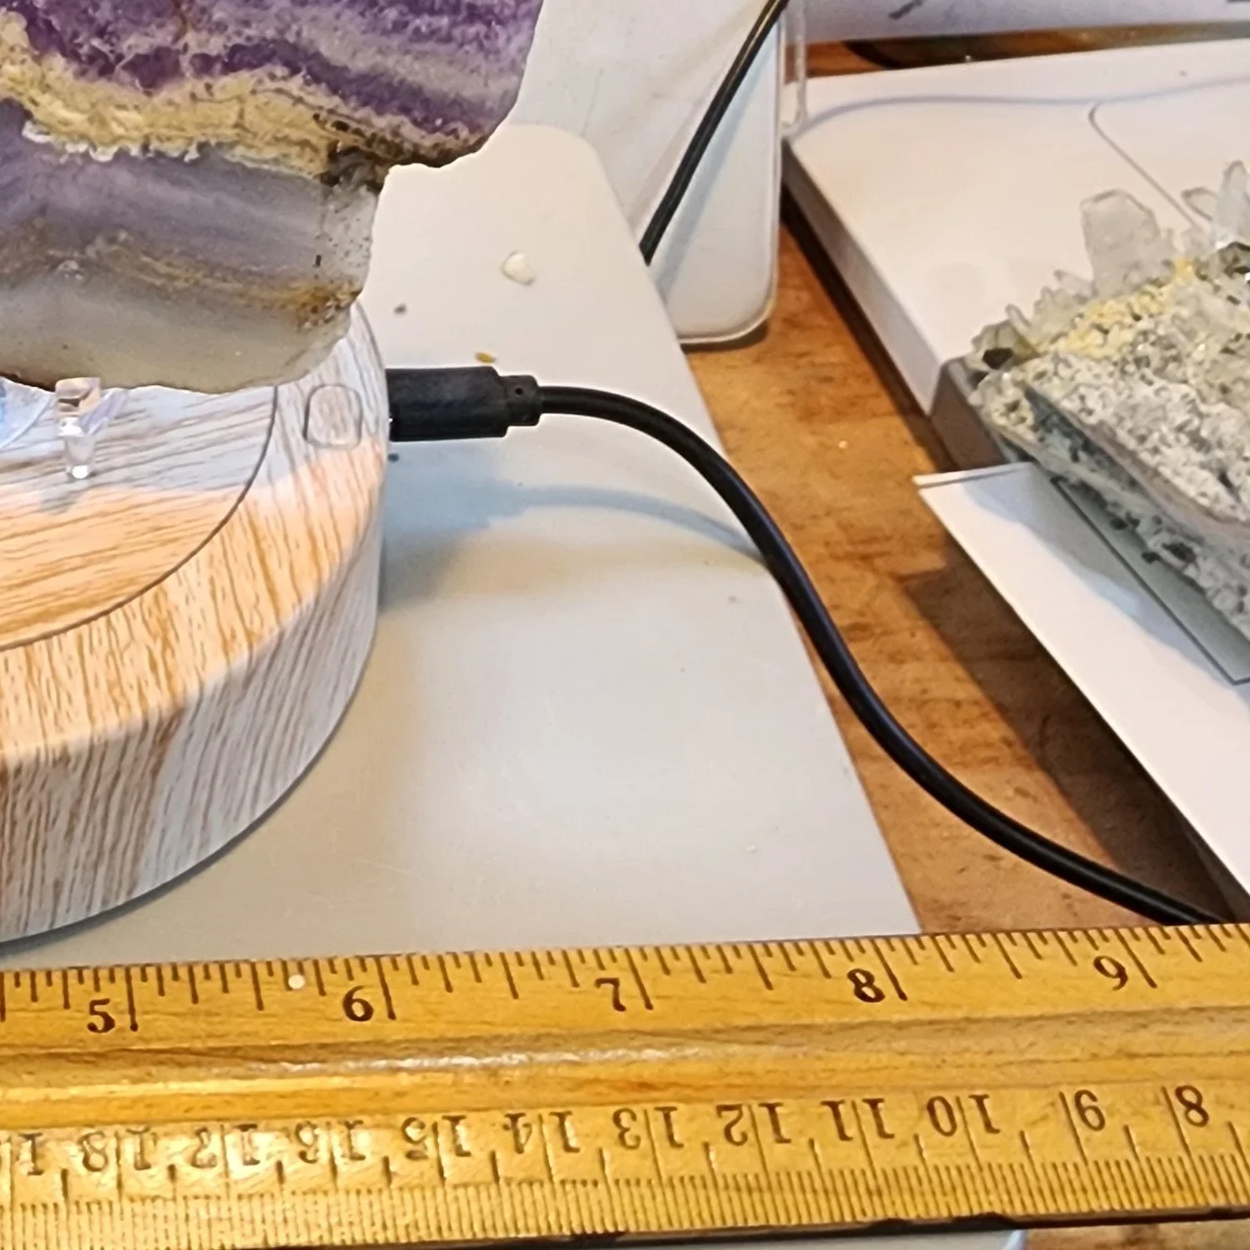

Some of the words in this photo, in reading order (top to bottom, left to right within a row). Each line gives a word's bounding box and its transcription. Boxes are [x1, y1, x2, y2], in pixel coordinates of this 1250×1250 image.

[87, 998, 117, 1033] 5
[343, 986, 373, 1022] 6
[595, 977, 626, 1011] 7
[848, 967, 883, 1004] 8
[1094, 955, 1128, 991] 9
[613, 1106, 684, 1150] 13
[717, 1102, 793, 1146] 12
[821, 1098, 897, 1141] 11
[927, 1093, 1002, 1137] 10
[1074, 1088, 1107, 1132] 9
[1176, 1084, 1210, 1129] 8
[82, 1128, 153, 1173] 18
[294, 1120, 366, 1162] 16
[403, 1113, 474, 1162] 15
[503, 1111, 581, 1155] 14
